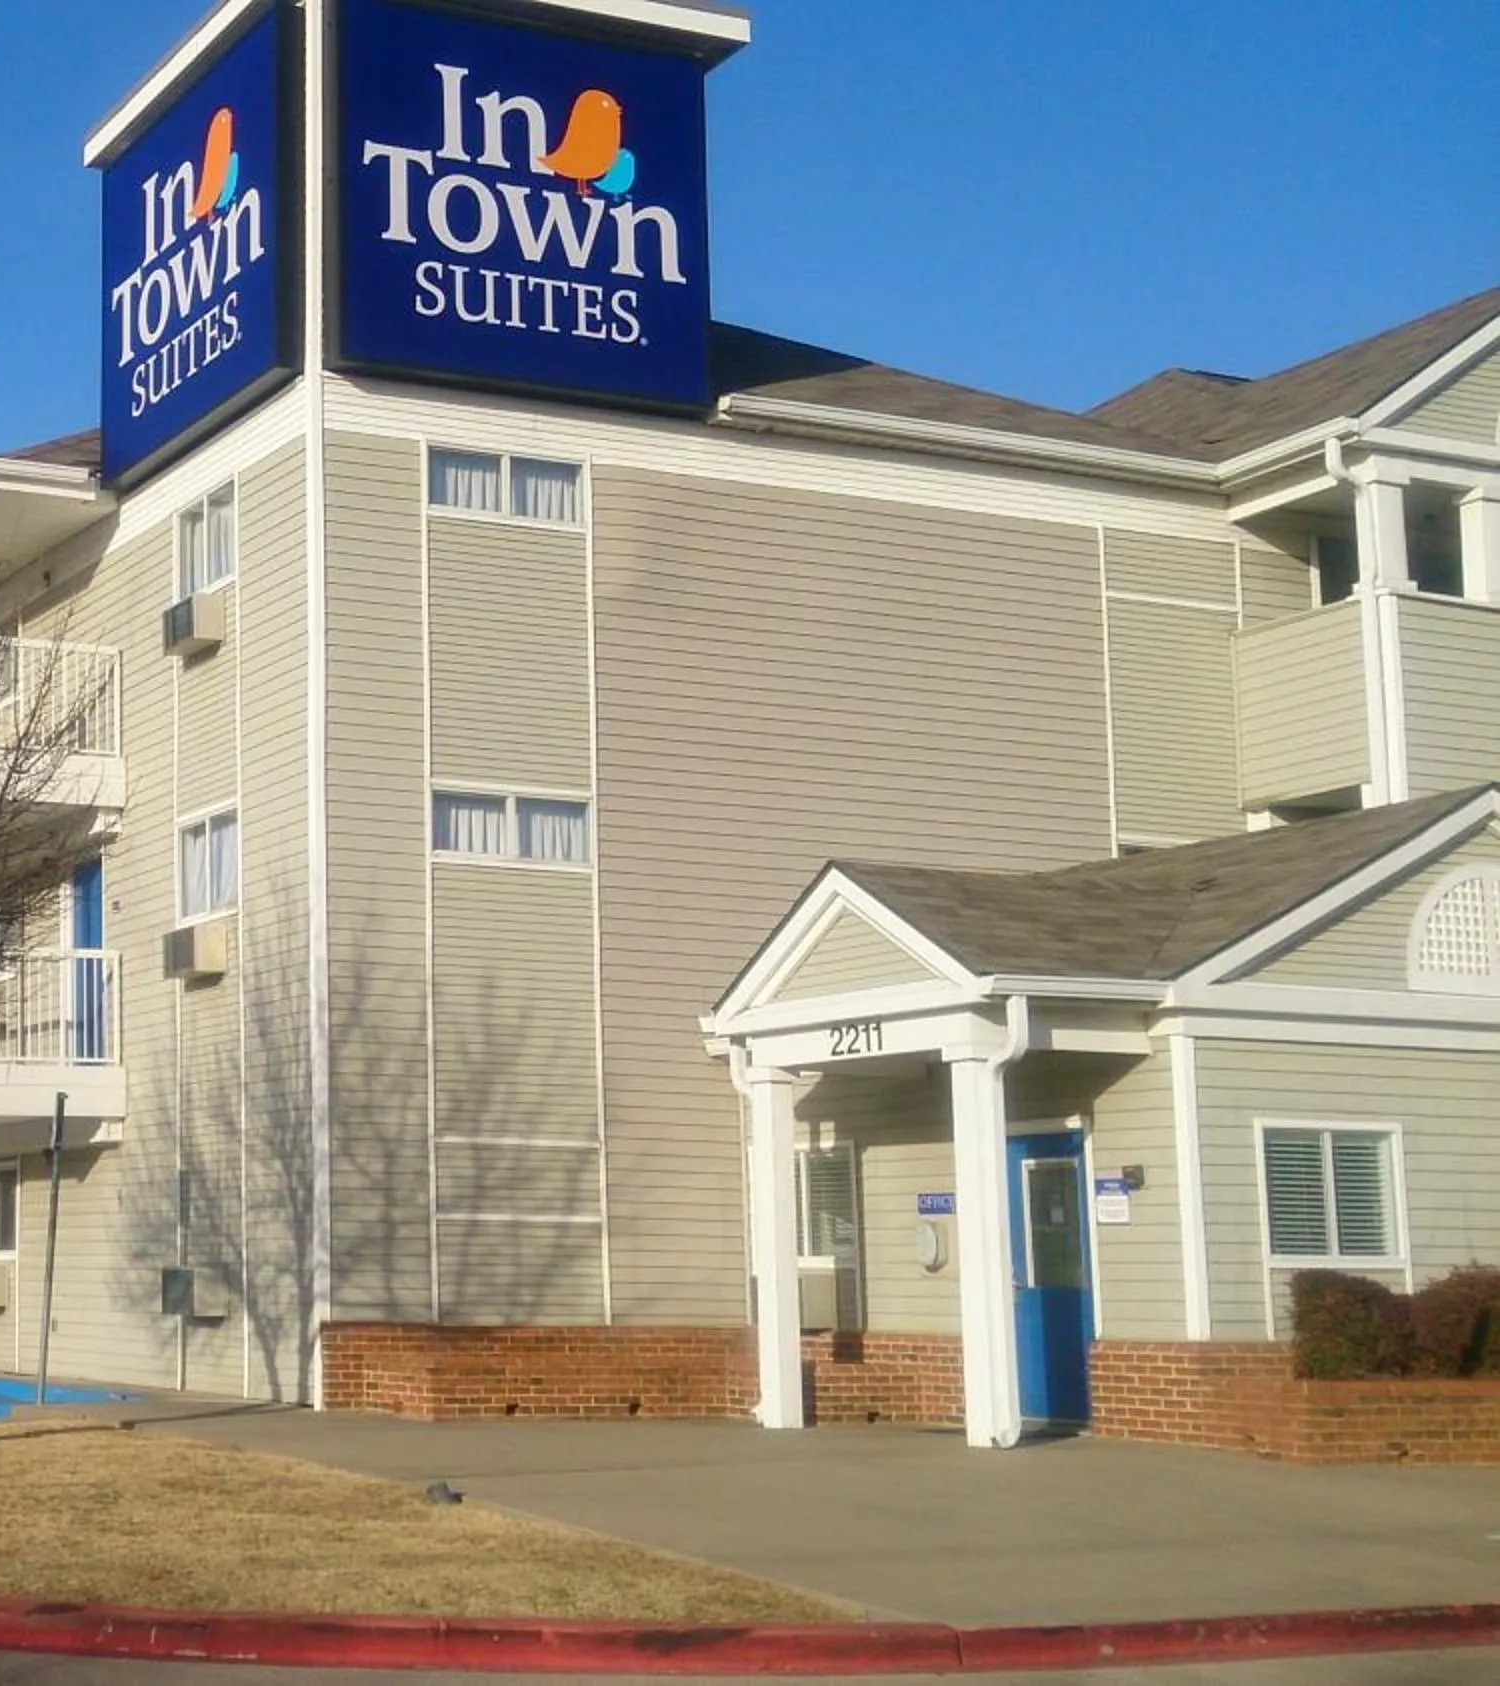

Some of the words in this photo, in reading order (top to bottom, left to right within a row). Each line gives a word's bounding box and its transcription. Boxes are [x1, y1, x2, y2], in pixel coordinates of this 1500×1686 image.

[435, 64, 555, 176] In
[142, 160, 197, 269] In
[830, 1020, 883, 1056] 2211
